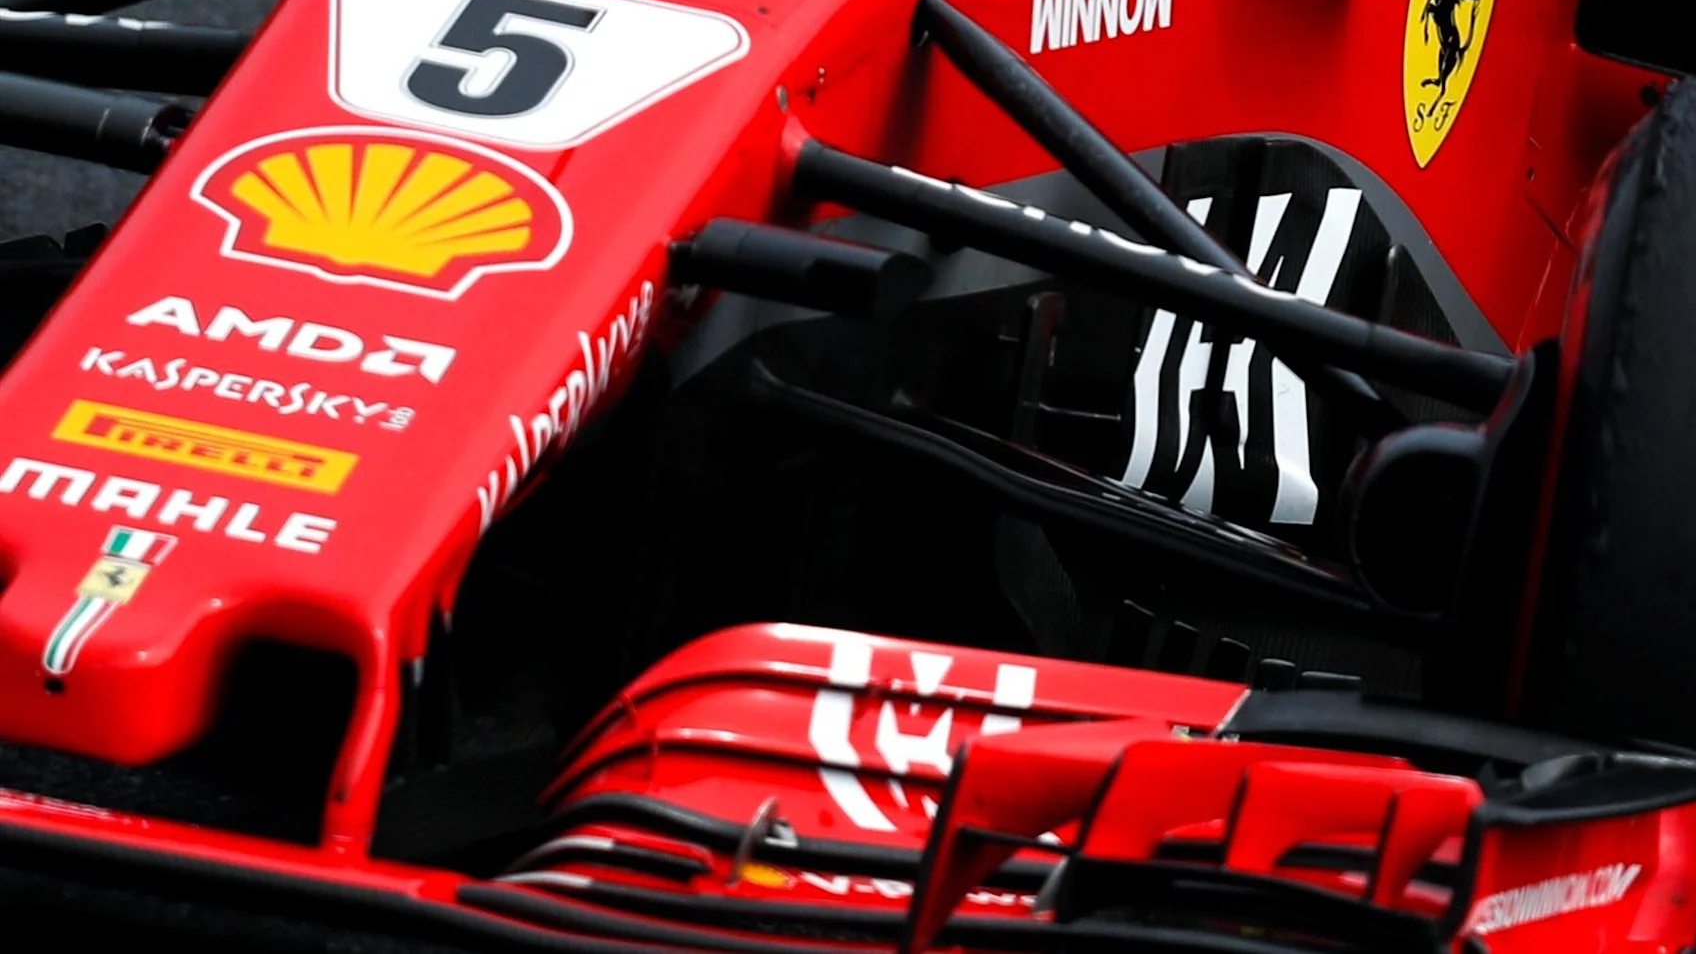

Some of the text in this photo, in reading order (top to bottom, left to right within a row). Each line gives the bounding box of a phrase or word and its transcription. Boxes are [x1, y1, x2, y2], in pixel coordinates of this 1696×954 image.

[126, 296, 364, 364] AMD
[80, 347, 388, 424] KASPERSKY
[84, 413, 328, 479] PIRELLI
[0, 457, 338, 554] MAHLE
